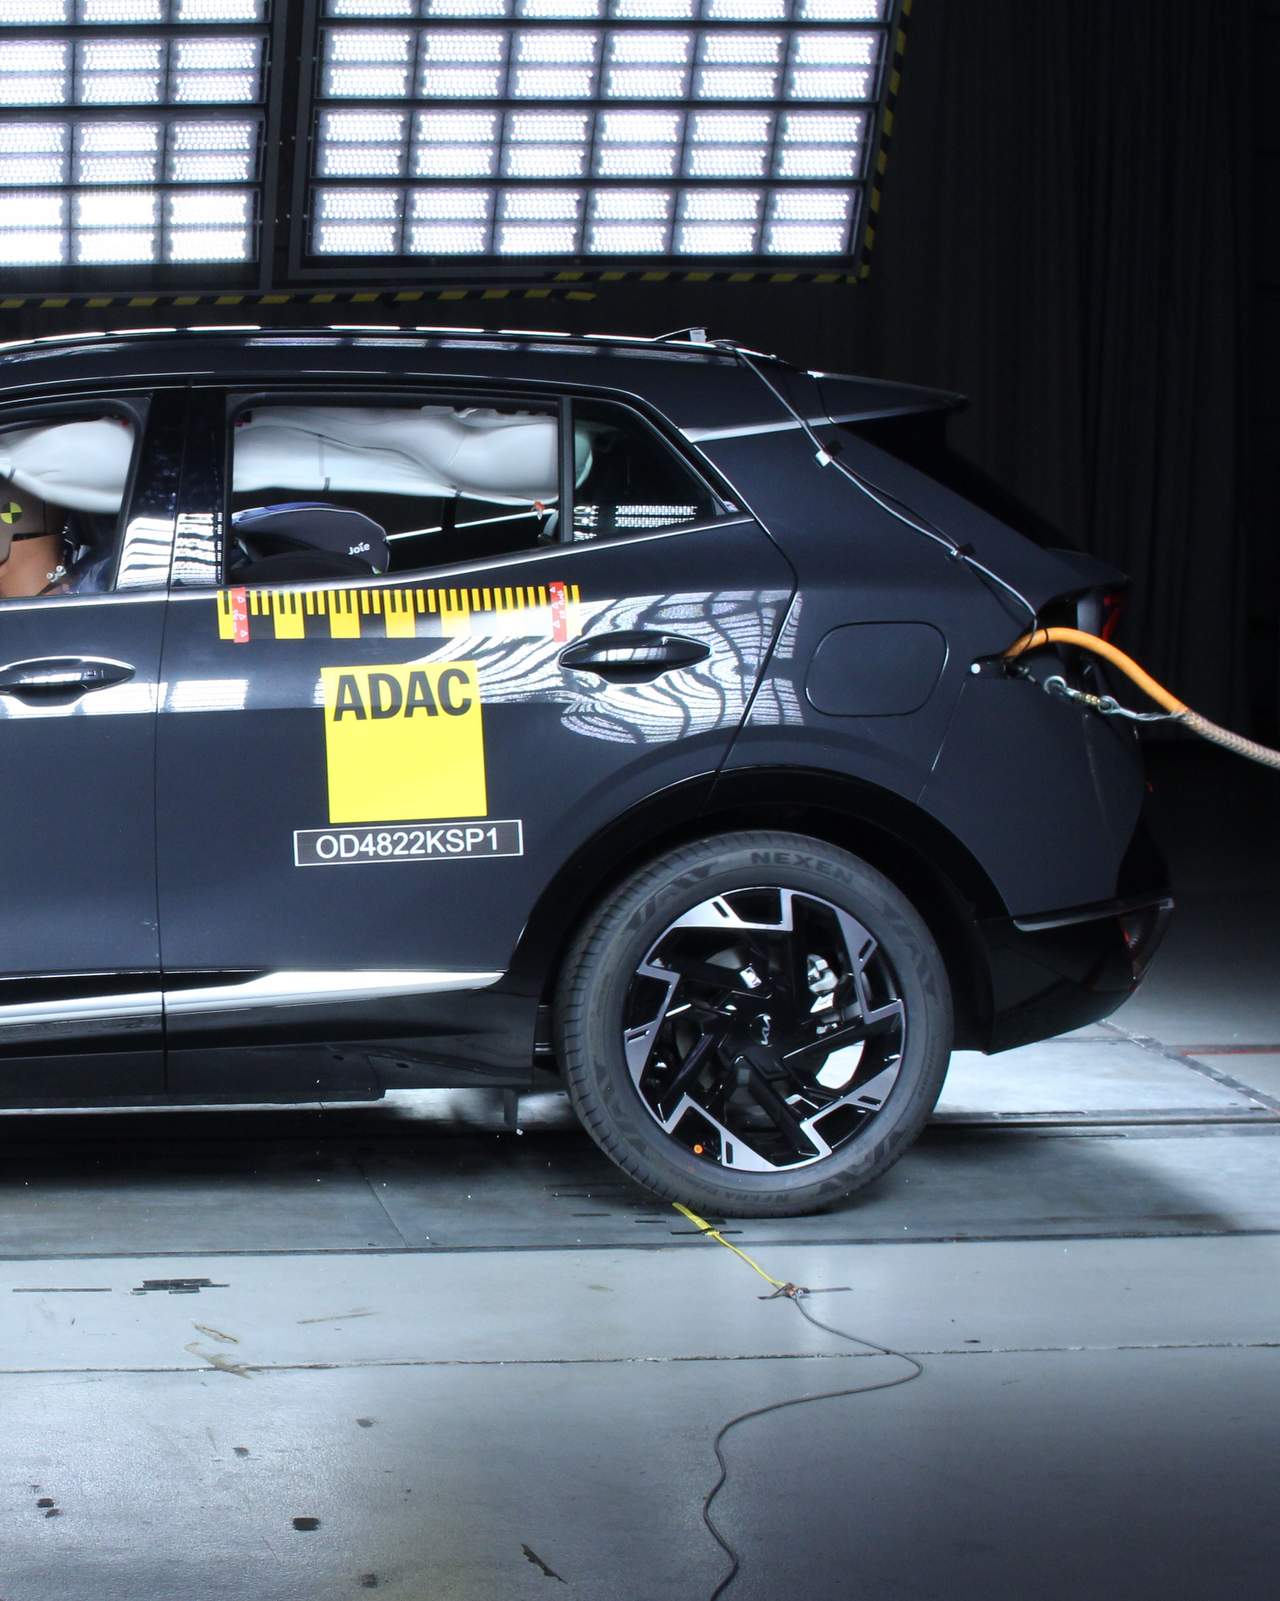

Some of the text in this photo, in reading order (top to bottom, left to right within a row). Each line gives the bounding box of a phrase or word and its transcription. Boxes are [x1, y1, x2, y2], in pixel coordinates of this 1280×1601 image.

[348, 542, 370, 555] Joie
[333, 668, 472, 721] ADAC
[316, 827, 498, 859] OD4822KSP1
[751, 851, 852, 883] NEXEN
